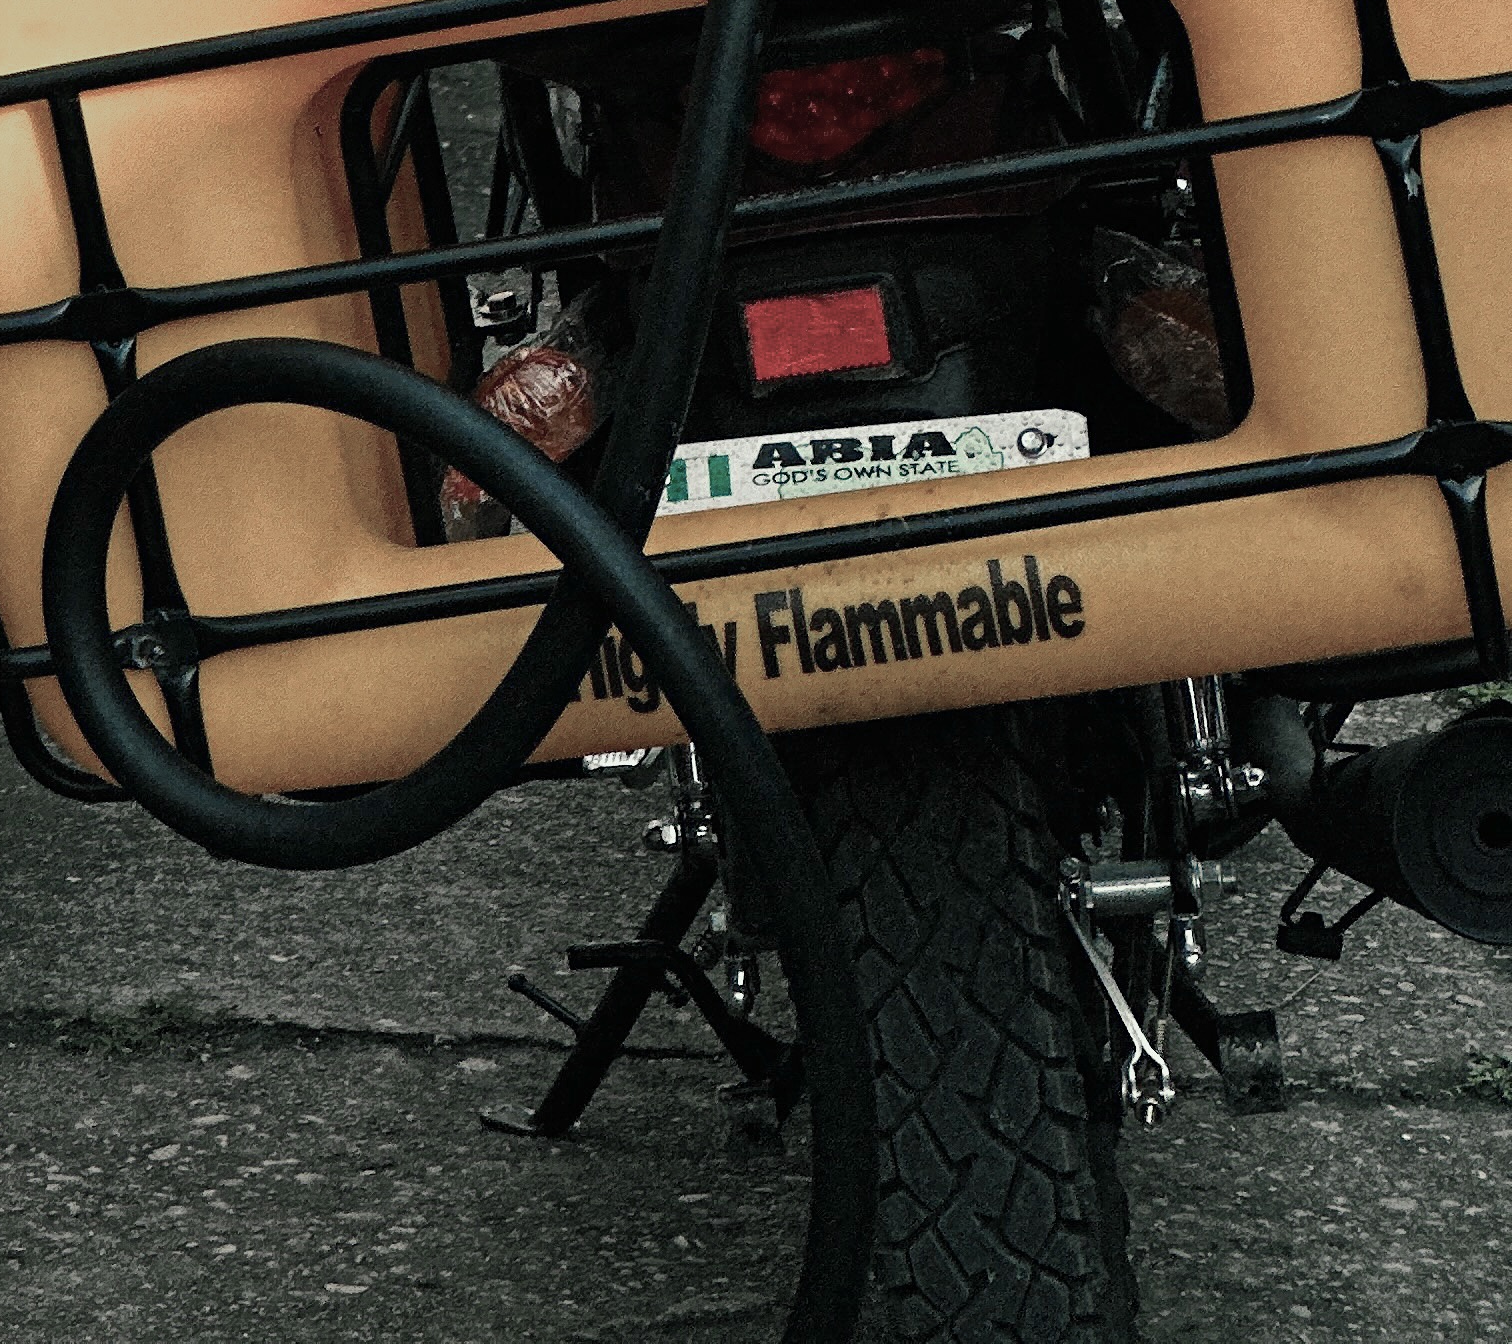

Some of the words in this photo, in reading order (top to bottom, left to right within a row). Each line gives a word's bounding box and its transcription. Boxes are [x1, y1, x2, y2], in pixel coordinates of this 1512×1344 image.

[752, 431, 957, 469] ABIA
[752, 468, 828, 487] GOD'S
[834, 465, 892, 481] OWN
[899, 461, 960, 477] STATE
[754, 555, 1087, 680] Flammable
